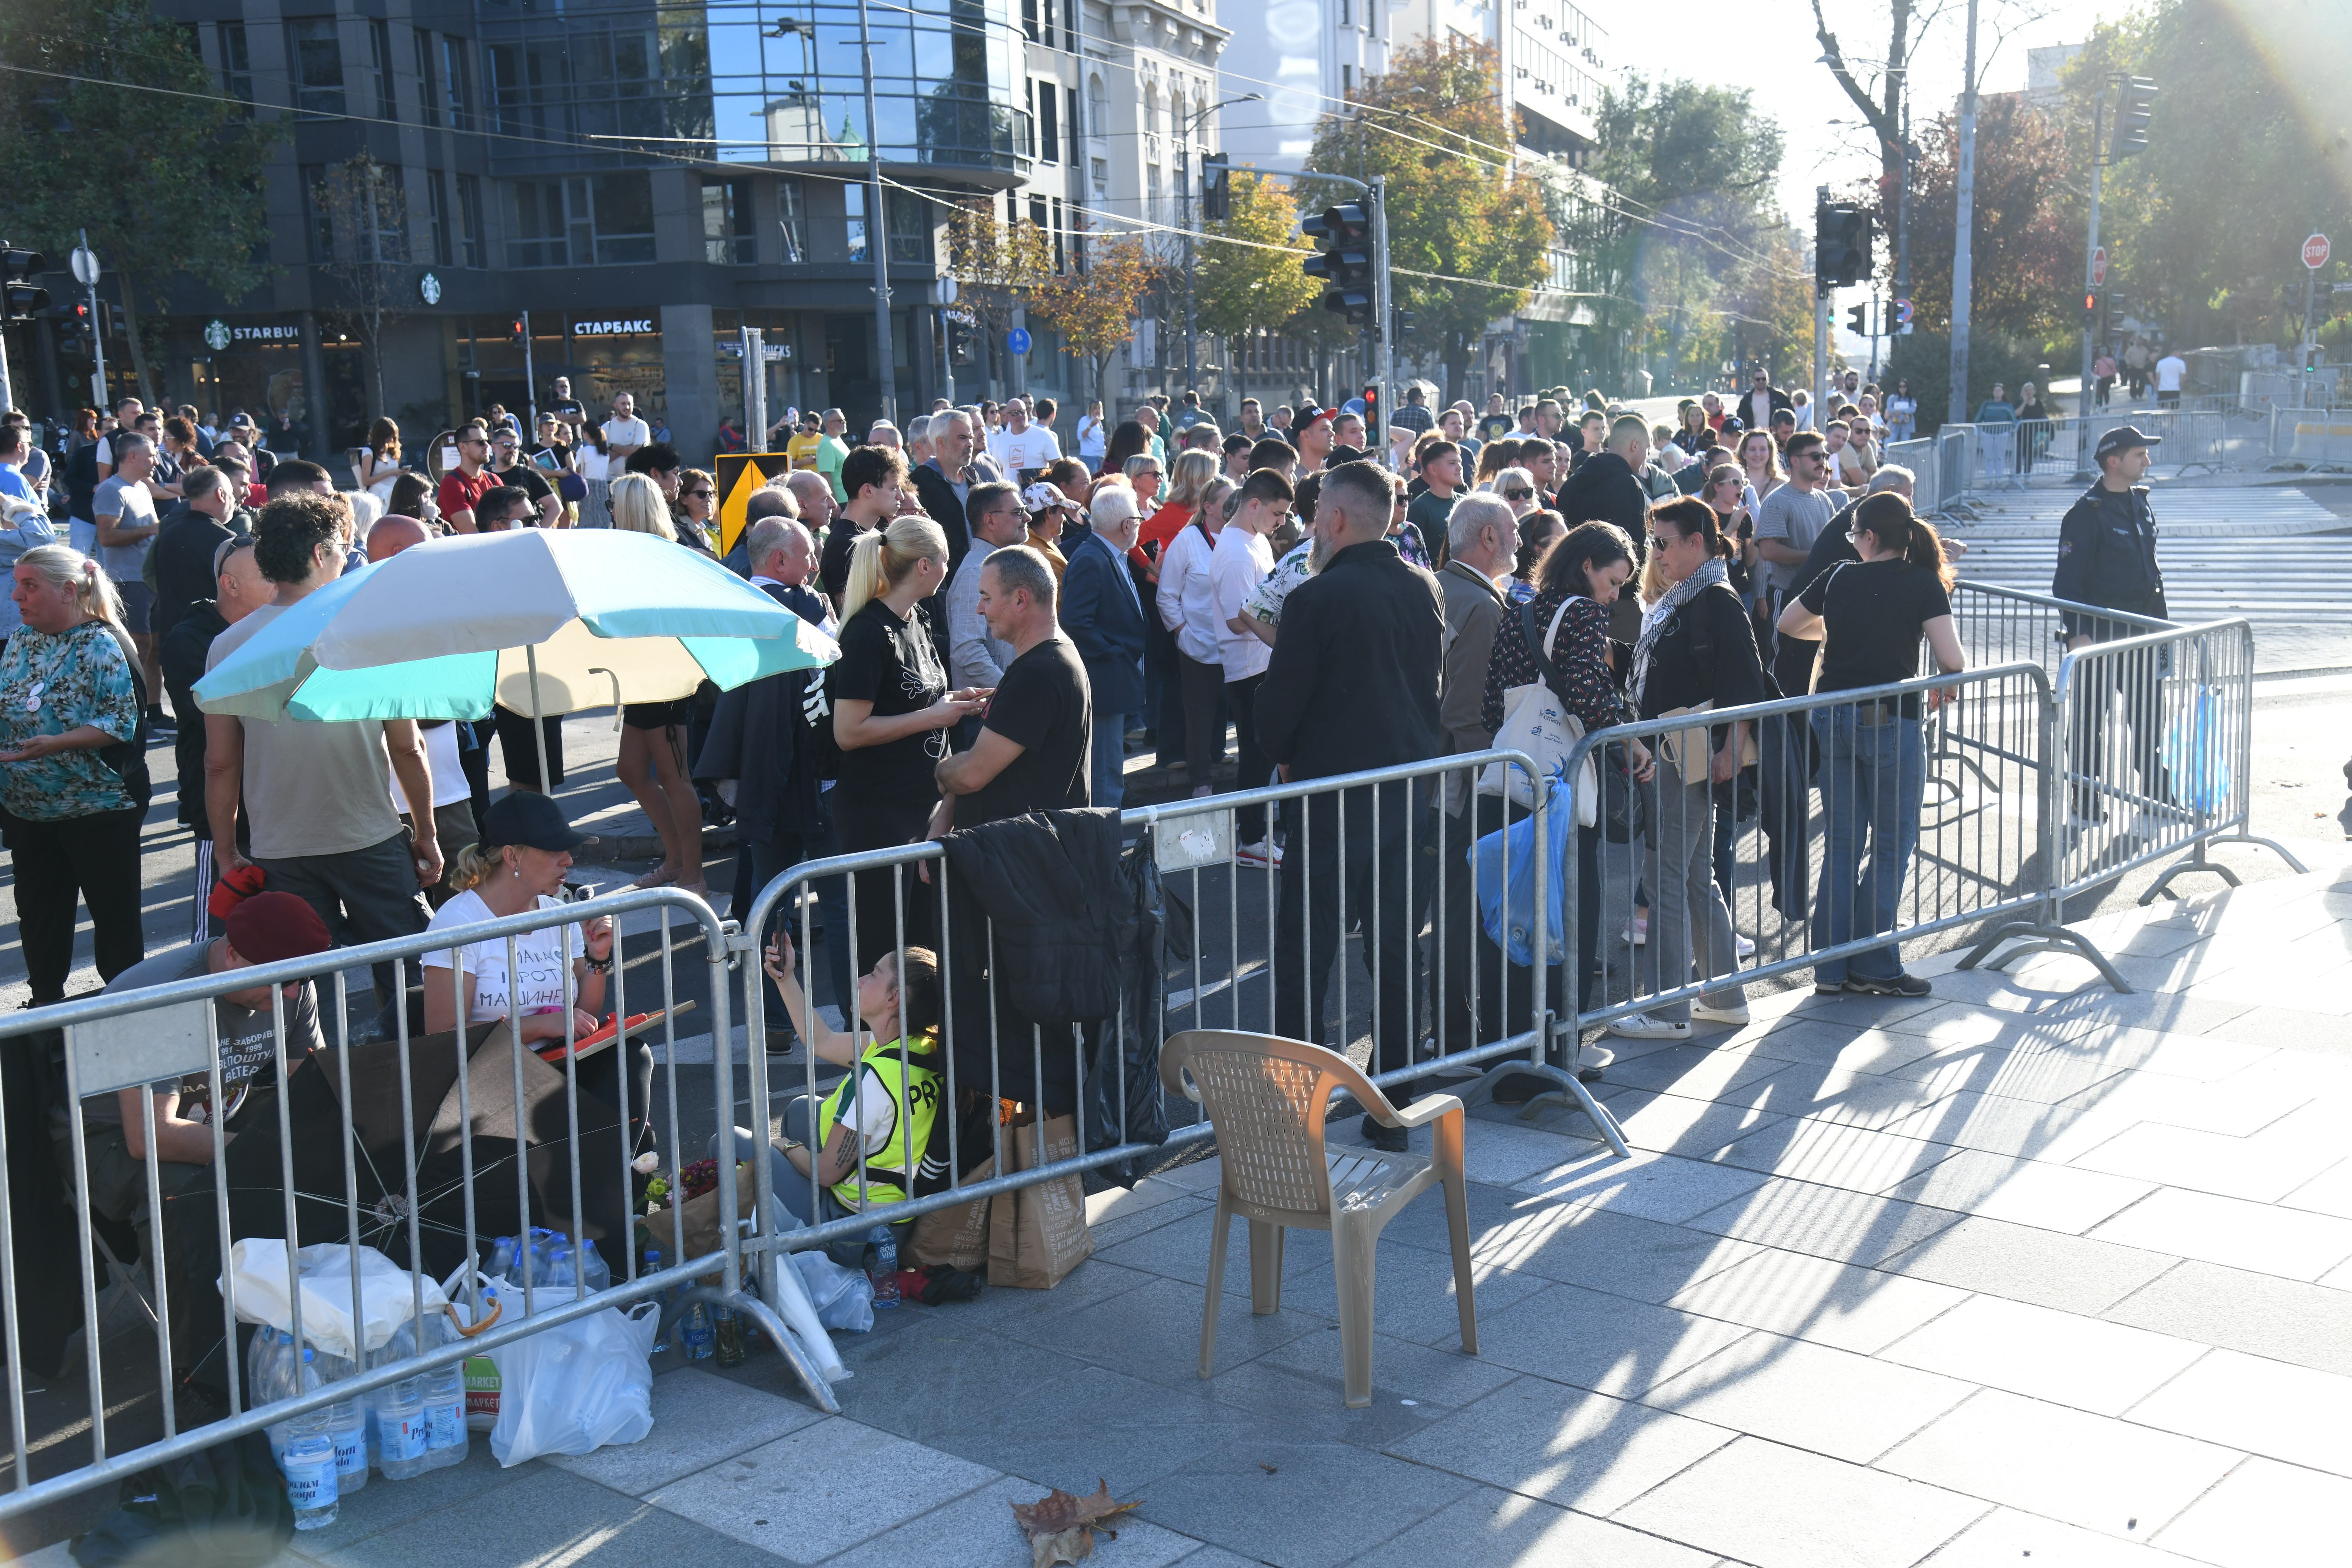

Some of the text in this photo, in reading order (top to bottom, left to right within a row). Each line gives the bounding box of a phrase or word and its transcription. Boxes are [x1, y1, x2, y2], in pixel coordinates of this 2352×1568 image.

[2306, 245, 2327, 258] STOP
[574, 320, 652, 334] СТАРБАКС
[245, 1043, 262, 1053] 1999
[225, 1065, 261, 1083] ВЕТЕР
[1057, 1182, 1067, 1194] BIN
[1040, 1184, 1054, 1215] ZDE JSEM
[1061, 1194, 1071, 1210] HIER
[966, 1202, 980, 1230] ZDE JSEM
[1056, 1231, 1066, 1240] ITT
[881, 1250, 896, 1258] viva
[957, 1257, 966, 1266] TU
[465, 1377, 500, 1388] MARKET
